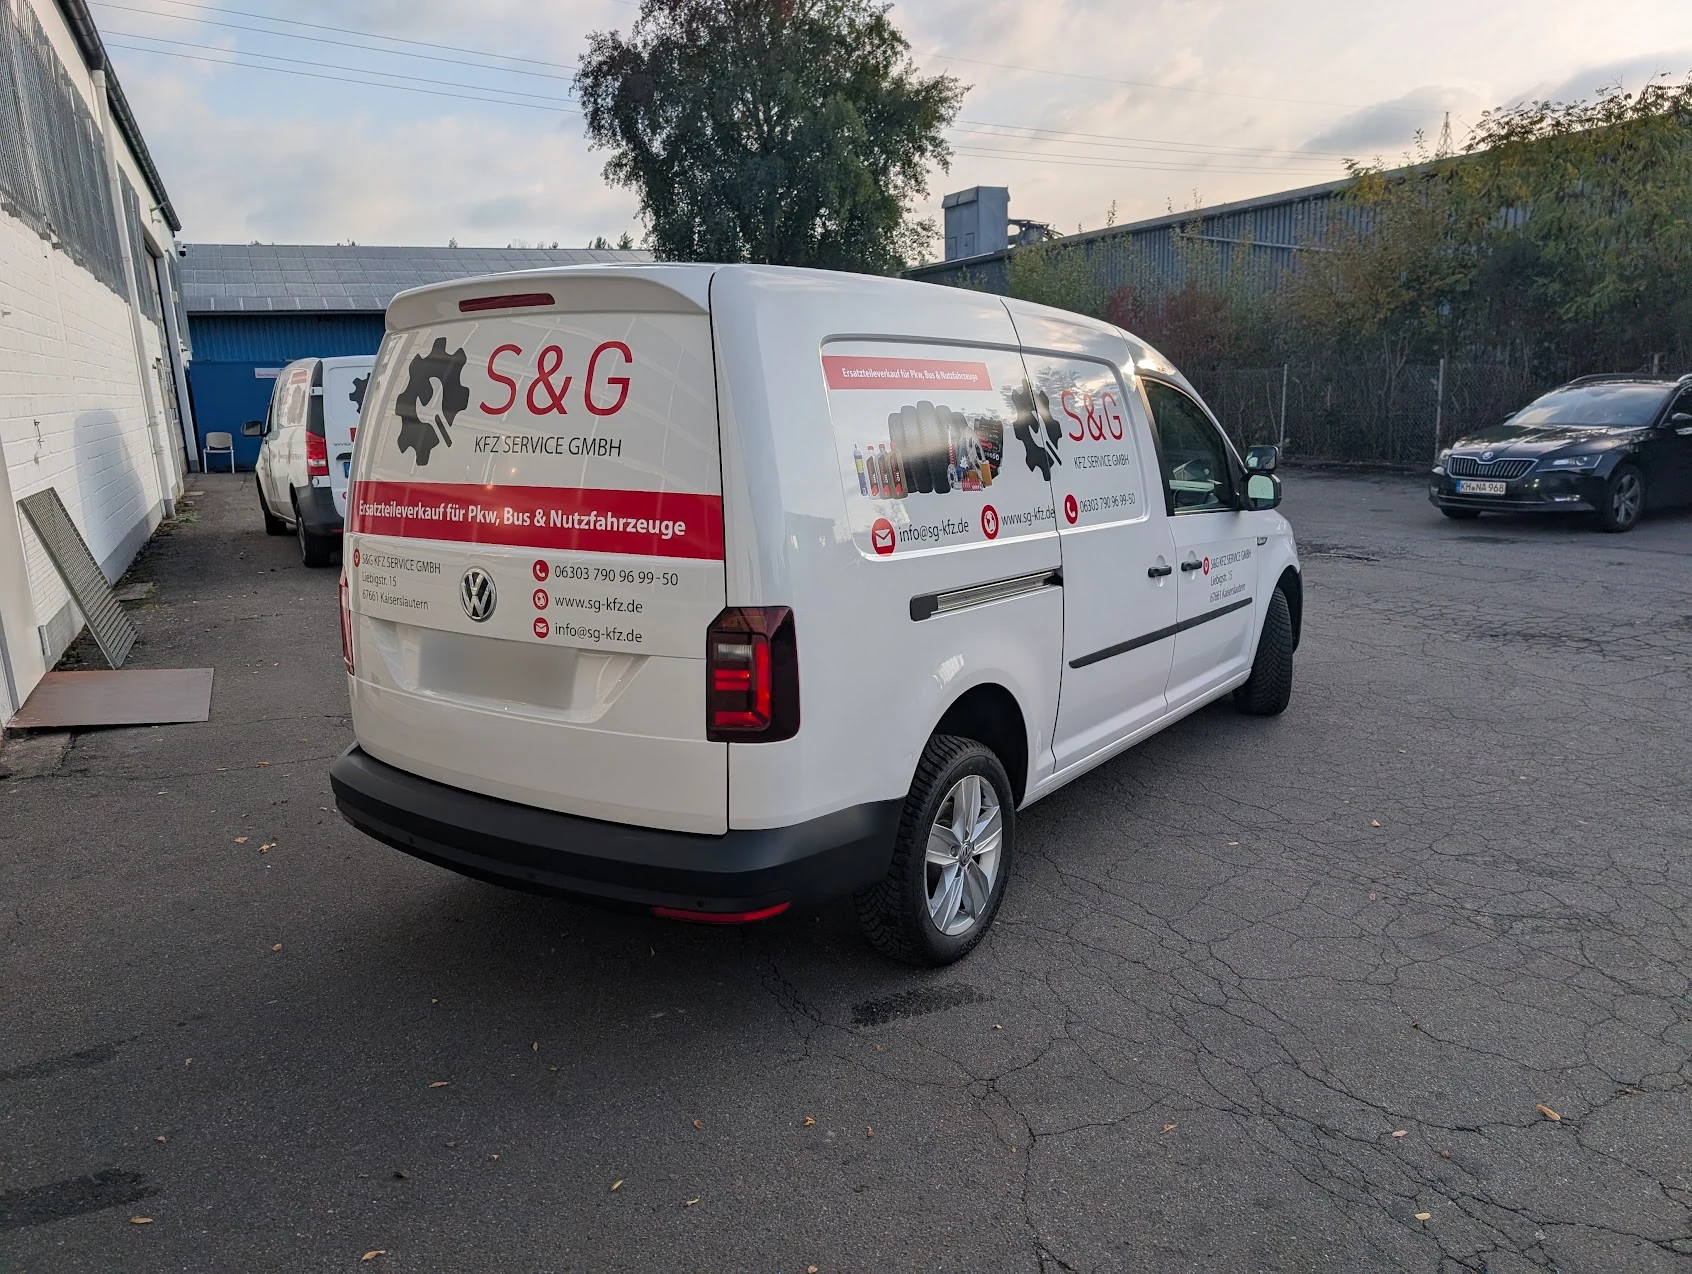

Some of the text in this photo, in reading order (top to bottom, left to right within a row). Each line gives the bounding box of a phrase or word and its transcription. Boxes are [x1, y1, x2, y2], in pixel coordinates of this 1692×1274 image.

[479, 341, 634, 416] S&G
[842, 368, 900, 379] Ersatzteileverkauf
[1061, 389, 1123, 442] S&G
[474, 436, 622, 458] KFZ SERVICE GMBH
[1074, 453, 1130, 470] KFZ SERVICE GMBH
[1460, 482, 1504, 493] KH NA 968
[1079, 500, 1099, 514] 06303
[1099, 497, 1111, 510] 790
[1111, 495, 1120, 508] 96
[359, 501, 687, 540] Ersatzteileverkauf für Pkw, Bus & Nutzfahrzeuge
[1001, 506, 1056, 526] www.sg-kfz.de
[898, 517, 970, 543] info@sg-kfz.de
[361, 553, 441, 574] S&G KFZ SERVICE GMBH
[362, 571, 397, 588] Liebigstr. 15
[554, 565, 590, 580] 06303
[593, 567, 616, 583] 790
[619, 569, 635, 584] 96
[362, 589, 429, 611] 67661 Kaiserslautern
[554, 596, 644, 613] www.sg-kfz.de
[555, 622, 643, 644] info@sg-kfz.de
